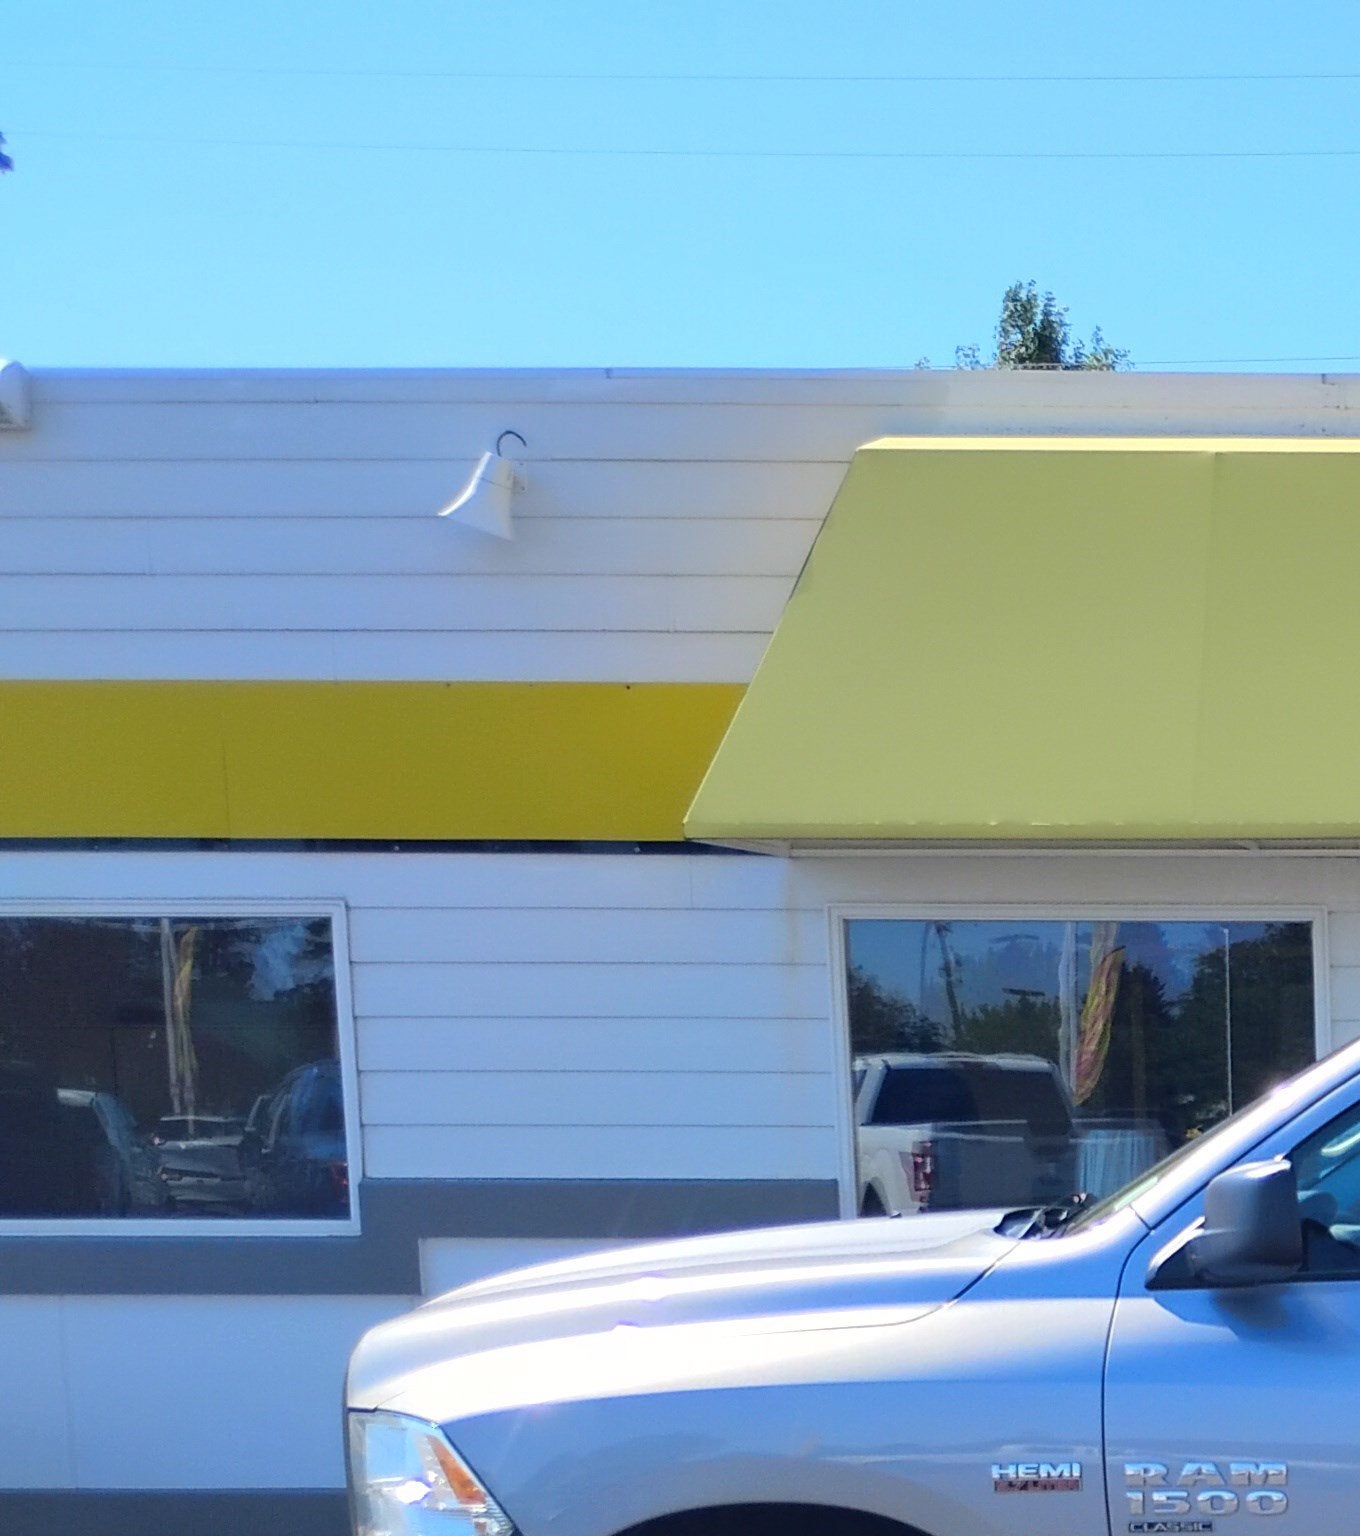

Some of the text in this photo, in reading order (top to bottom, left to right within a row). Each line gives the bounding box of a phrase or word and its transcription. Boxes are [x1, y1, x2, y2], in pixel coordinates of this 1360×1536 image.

[991, 1462, 1082, 1479] HEMI
[1123, 1462, 1289, 1487] RAM
[1125, 1490, 1289, 1515] 1500
[1128, 1521, 1214, 1533] CLASSIC
